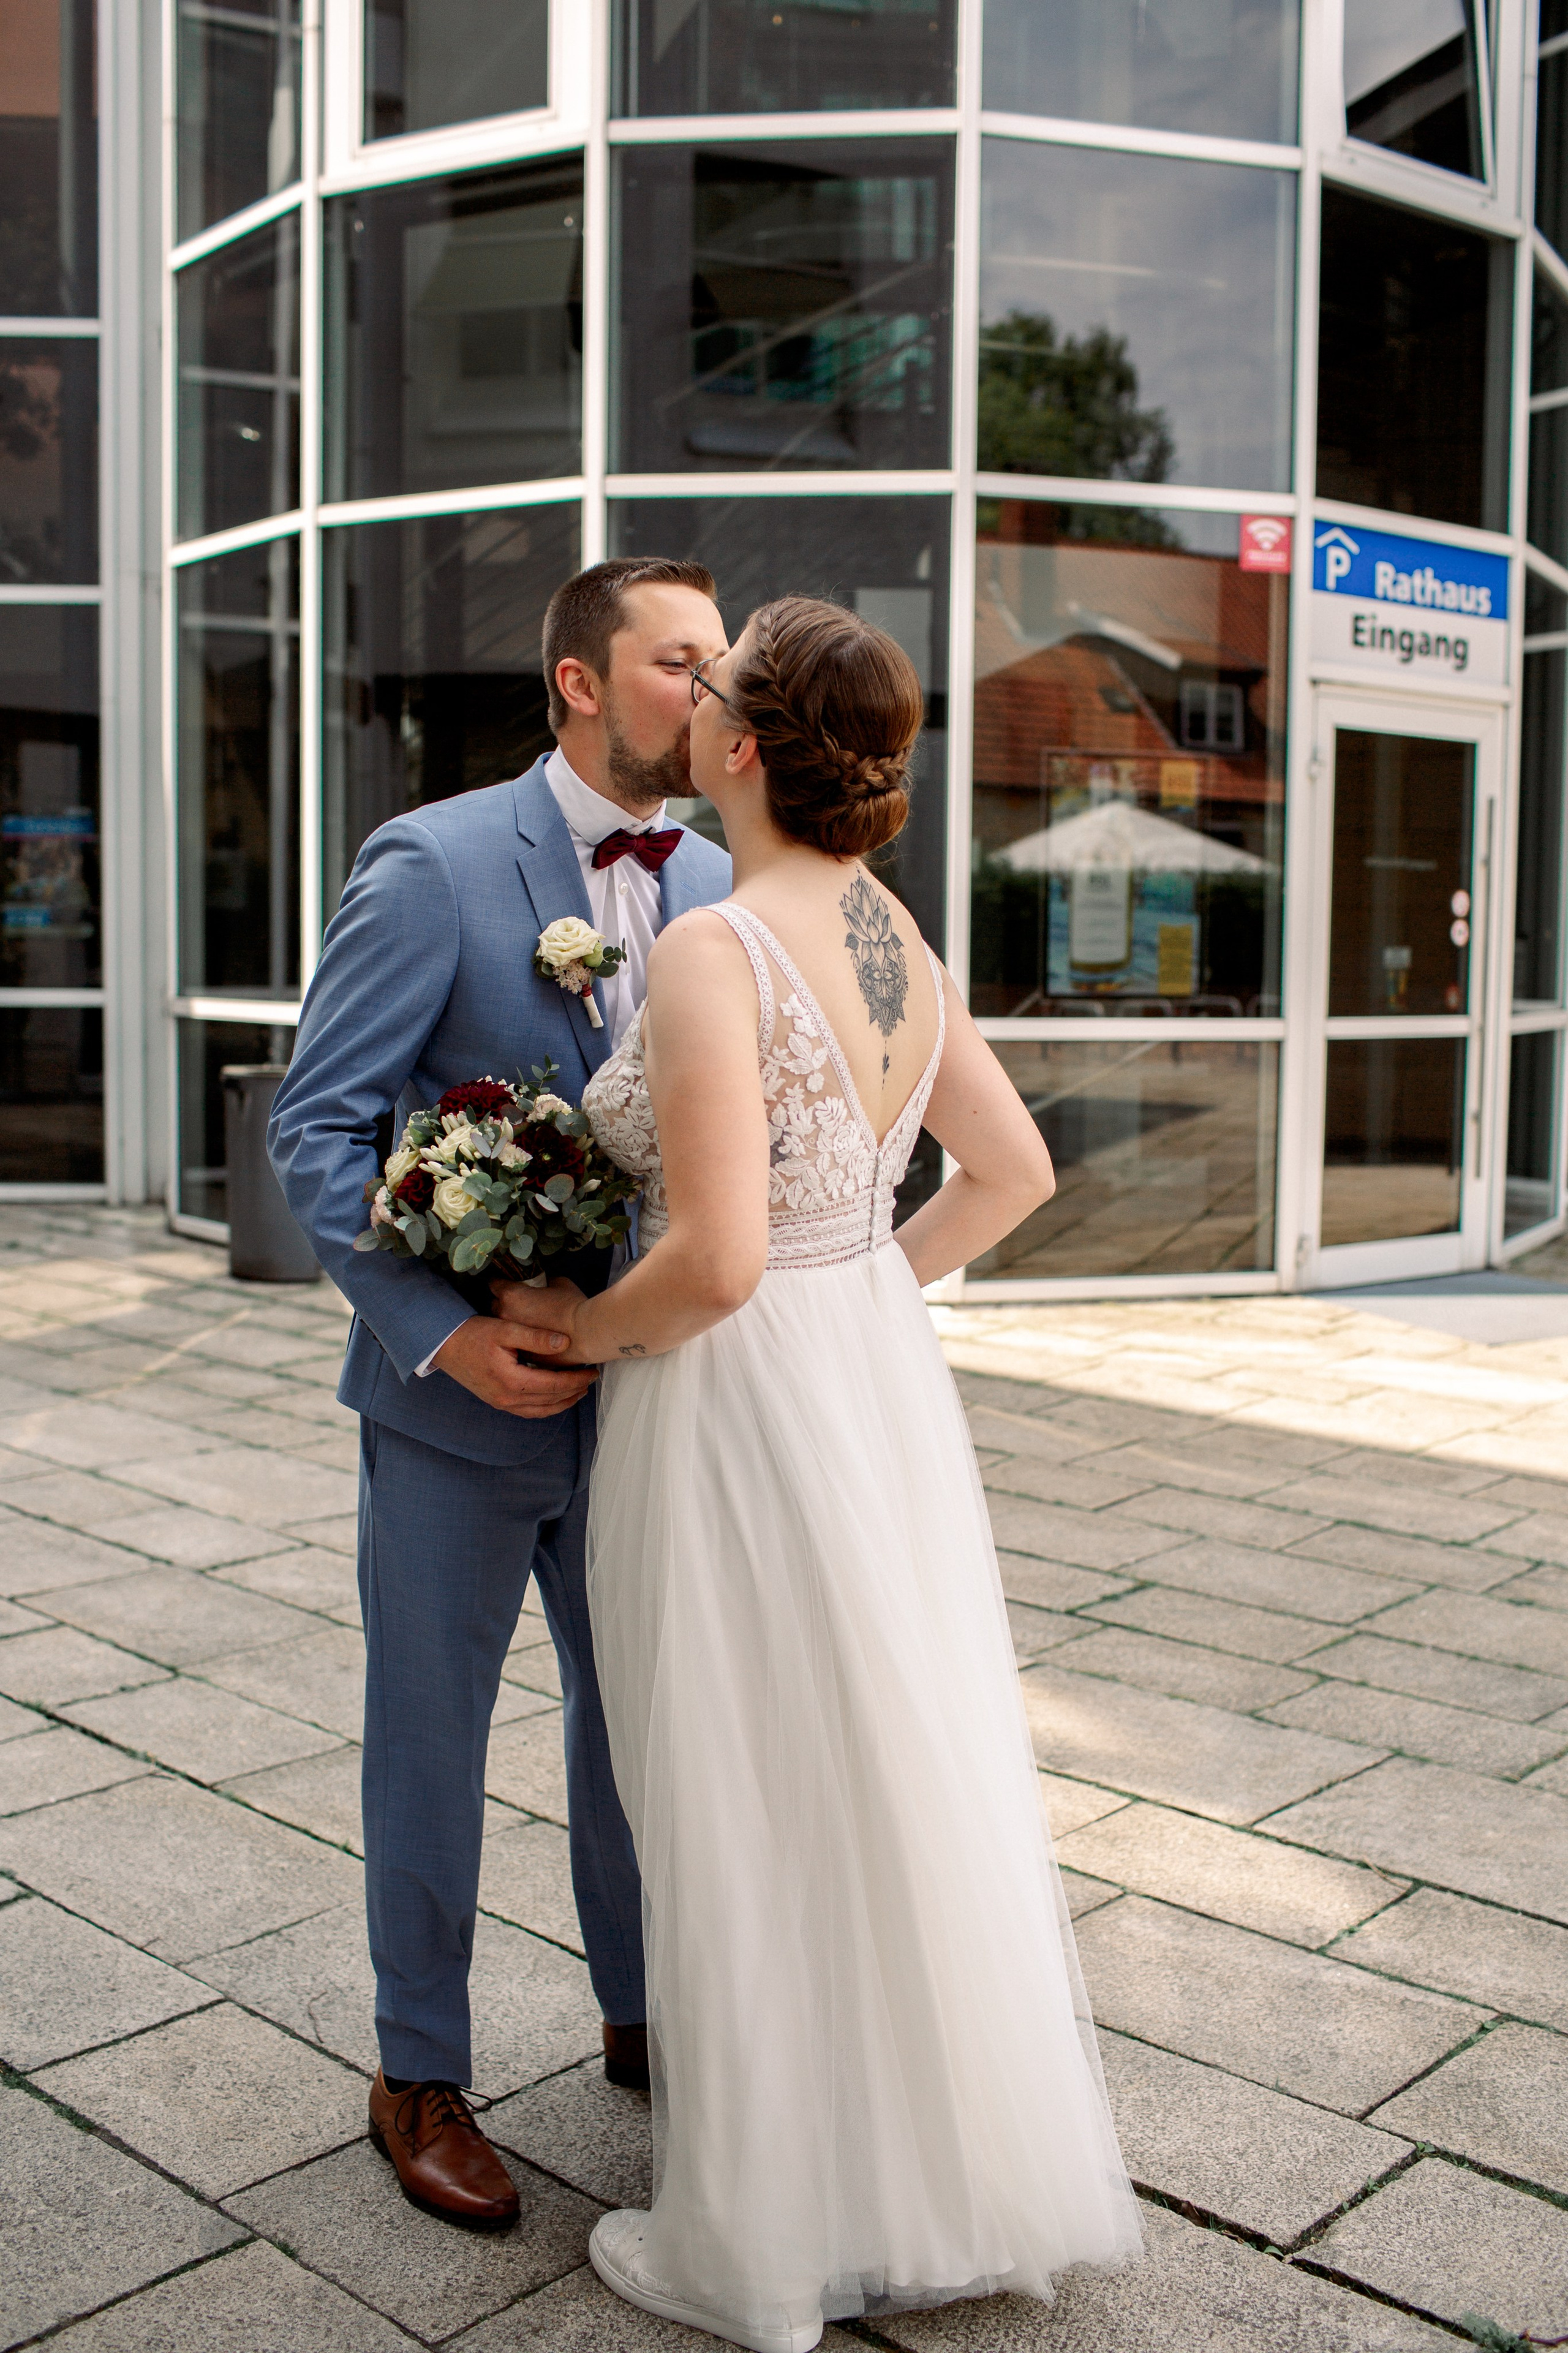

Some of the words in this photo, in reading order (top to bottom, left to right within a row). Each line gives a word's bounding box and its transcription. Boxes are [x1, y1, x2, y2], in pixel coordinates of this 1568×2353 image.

[1325, 545, 1351, 591] P
[1374, 561, 1492, 615] Rathaus
[1351, 614, 1468, 669] Eingang
